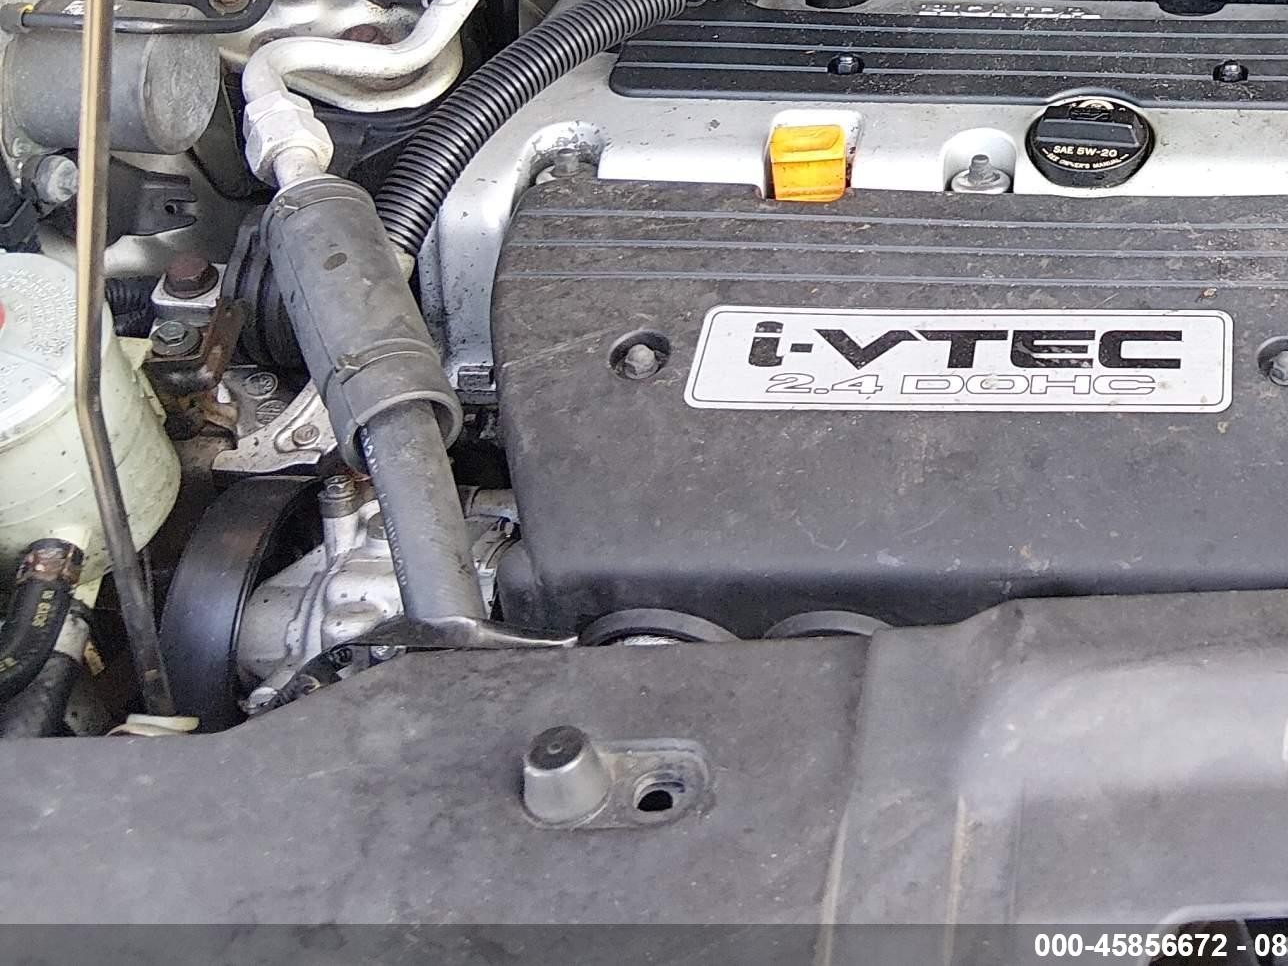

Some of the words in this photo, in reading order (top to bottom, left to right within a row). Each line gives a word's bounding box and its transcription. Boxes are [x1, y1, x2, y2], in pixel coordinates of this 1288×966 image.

[1053, 145, 1075, 155] SAE
[1076, 147, 1118, 158] 5W-20
[748, 321, 1183, 370] i-VTEC
[765, 373, 884, 395] 2.4
[900, 373, 1157, 396] DOHC
